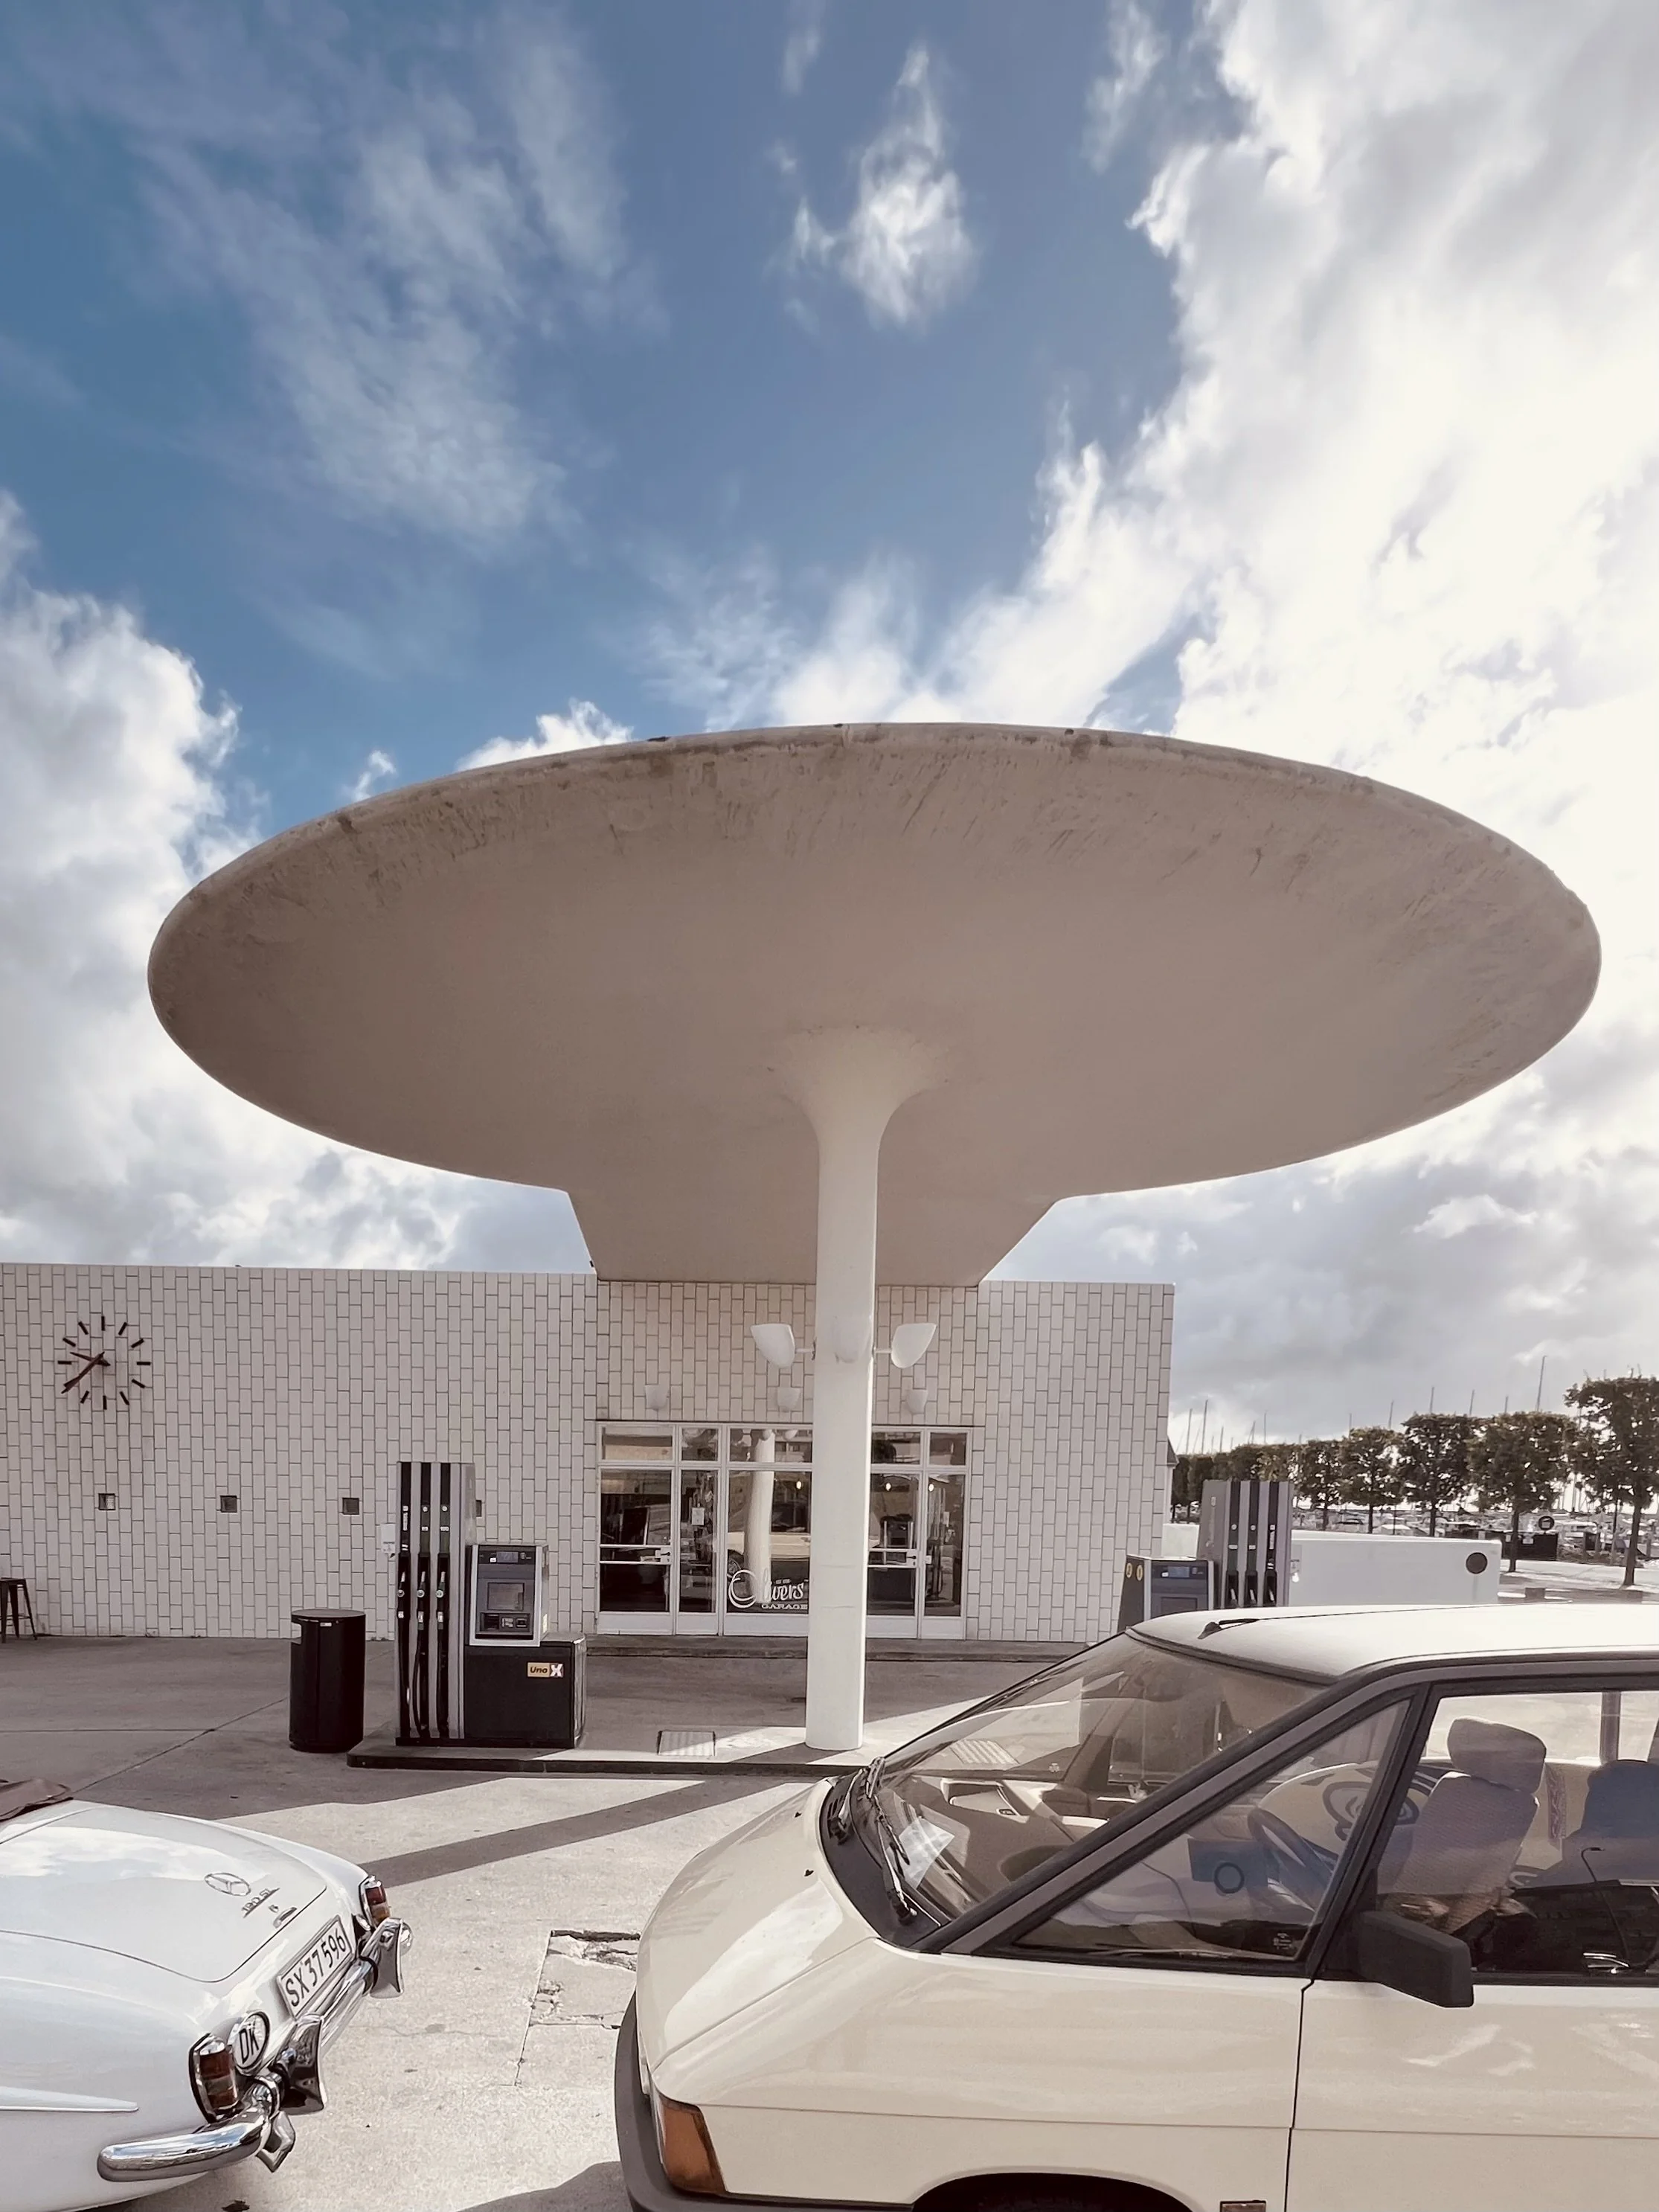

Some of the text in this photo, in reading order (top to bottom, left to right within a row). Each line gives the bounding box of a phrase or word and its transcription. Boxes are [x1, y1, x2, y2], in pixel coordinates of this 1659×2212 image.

[550, 1663, 563, 1676] X
[285, 1928, 346, 2007] SX 37 596
[239, 2019, 260, 2064] DK
